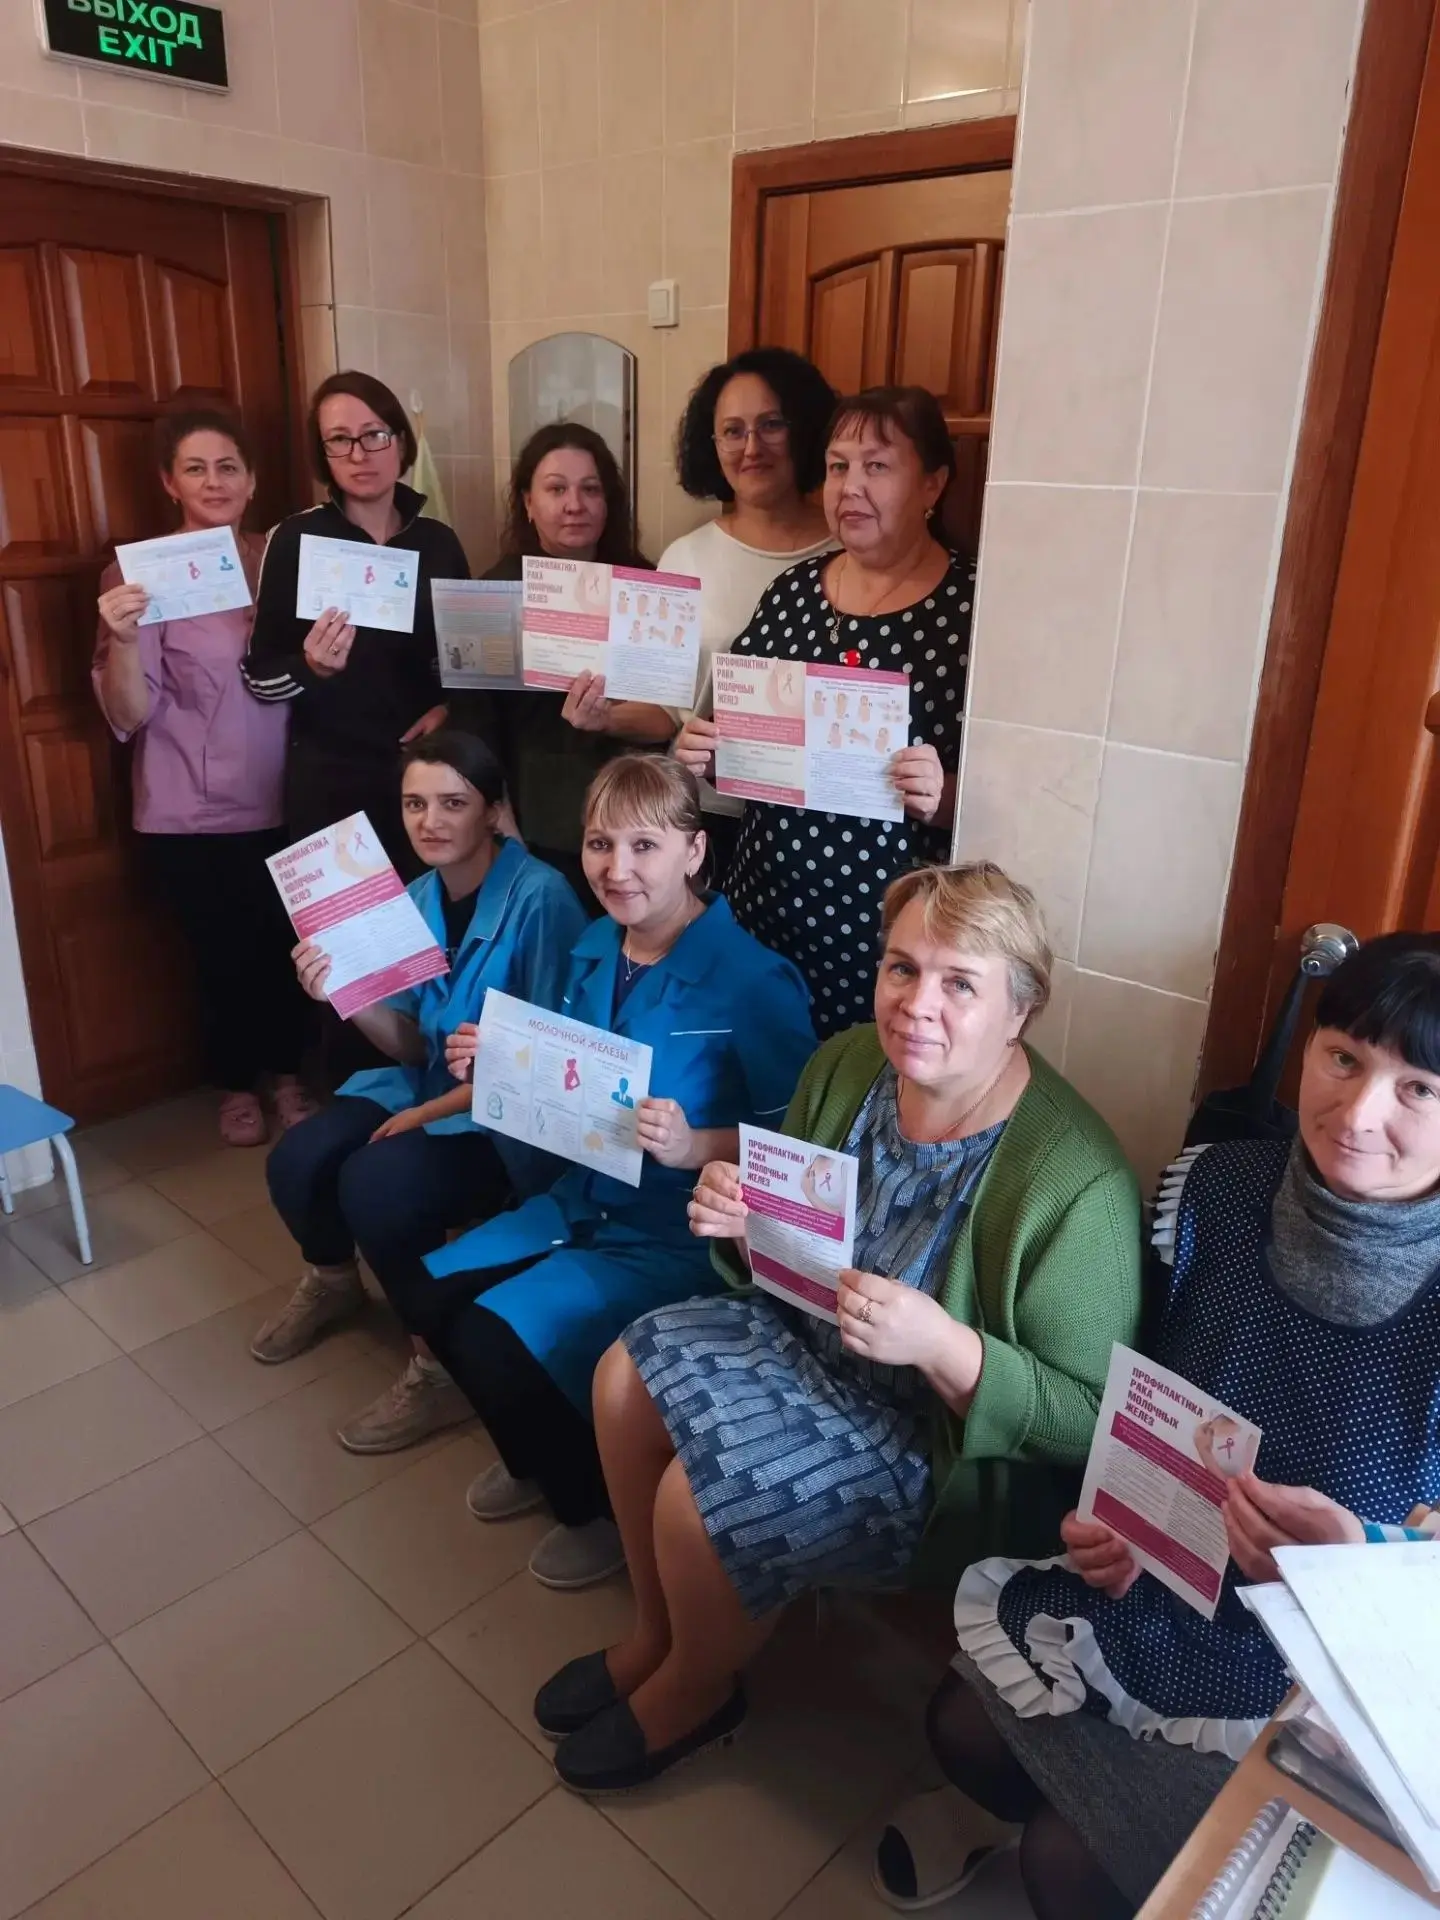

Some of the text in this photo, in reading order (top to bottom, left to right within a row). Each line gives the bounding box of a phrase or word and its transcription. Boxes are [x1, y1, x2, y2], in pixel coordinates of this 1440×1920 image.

[98, 25, 178, 67] EXIT
[527, 1018, 630, 1062] МОЛОЧНОЙ ЖЕЛЕЗЫ
[748, 1139, 805, 1165] ПРОФИЛАКТИКА
[748, 1149, 766, 1163] РАКА
[747, 1160, 788, 1182] МОЛОЧНЫХ
[747, 1171, 771, 1188] ЖЕЛЕЗ
[1128, 1378, 1153, 1400] РАКА
[1131, 1367, 1204, 1418] ПРОФИЛАКТИКА
[1124, 1400, 1155, 1427] ЖЕЛЕЗ
[1127, 1389, 1179, 1430] МОЛОЧНЫХ
